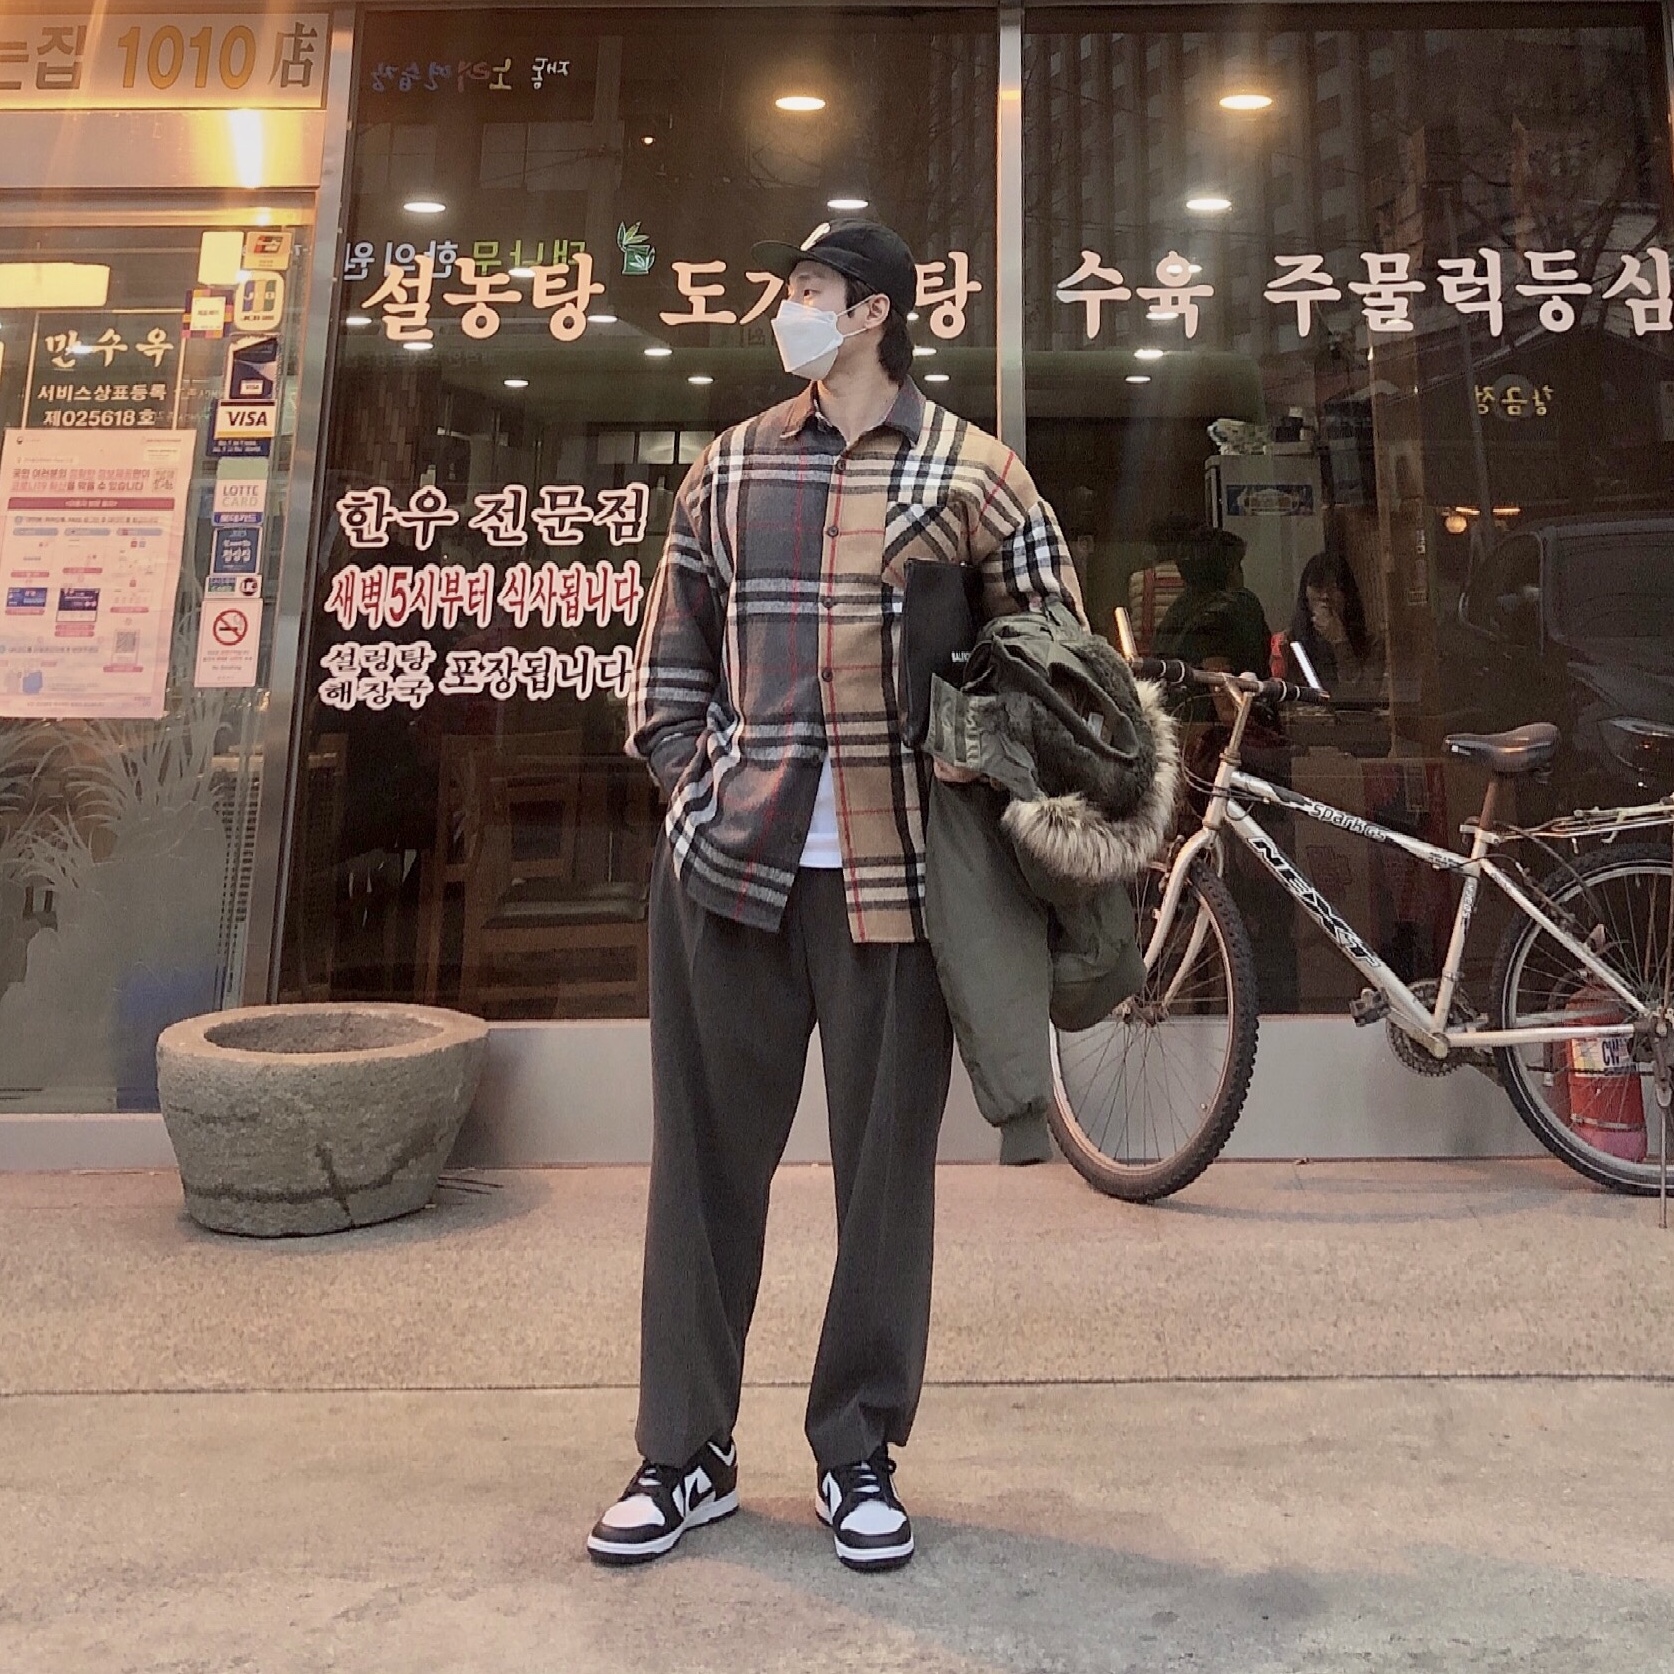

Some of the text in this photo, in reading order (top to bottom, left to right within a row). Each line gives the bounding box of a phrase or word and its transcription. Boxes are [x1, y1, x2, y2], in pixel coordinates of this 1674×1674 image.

[118, 25, 256, 90] 1010
[268, 21, 319, 88] 店
[361, 252, 605, 342] 설농탕
[1056, 250, 1214, 339] 수육
[1263, 247, 1674, 337] 주물럭등심
[45, 328, 174, 368] 만수옥
[38, 383, 166, 402] 서비스상표등록
[43, 408, 156, 427] 제025618호
[227, 411, 267, 426] VISA
[221, 496, 258, 508] CARD
[223, 484, 259, 497] LOTTE
[336, 482, 649, 550] 한우 전문점
[324, 560, 644, 629] 새벽5시부터 식사됩니다
[320, 641, 437, 676] 설렁탕
[439, 645, 635, 700] 포장됩니다
[318, 675, 434, 711] 해장국
[1248, 837, 1382, 967] NEXT
